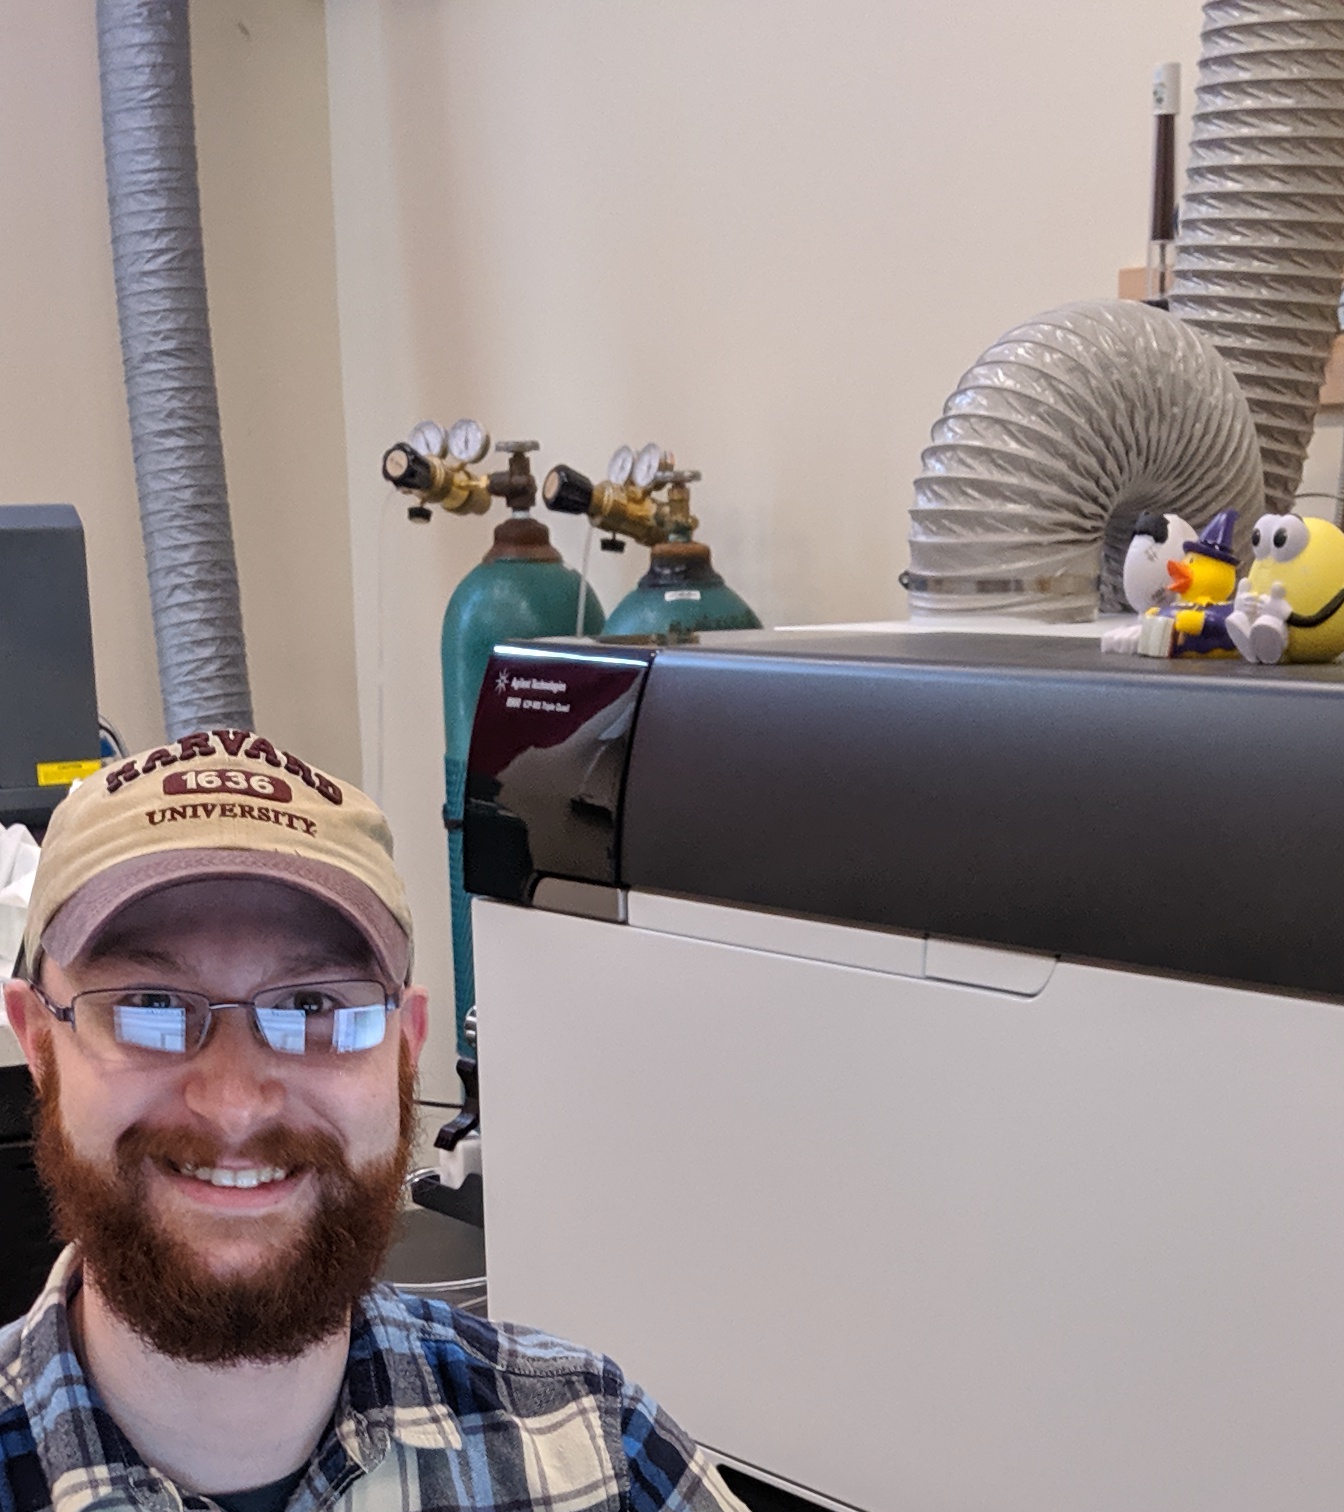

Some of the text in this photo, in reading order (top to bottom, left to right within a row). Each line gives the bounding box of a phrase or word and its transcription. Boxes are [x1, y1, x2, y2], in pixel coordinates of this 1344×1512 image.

[106, 730, 343, 805] HARVARD
[181, 770, 276, 796] 1636
[145, 803, 318, 838] UNIVERSITY
